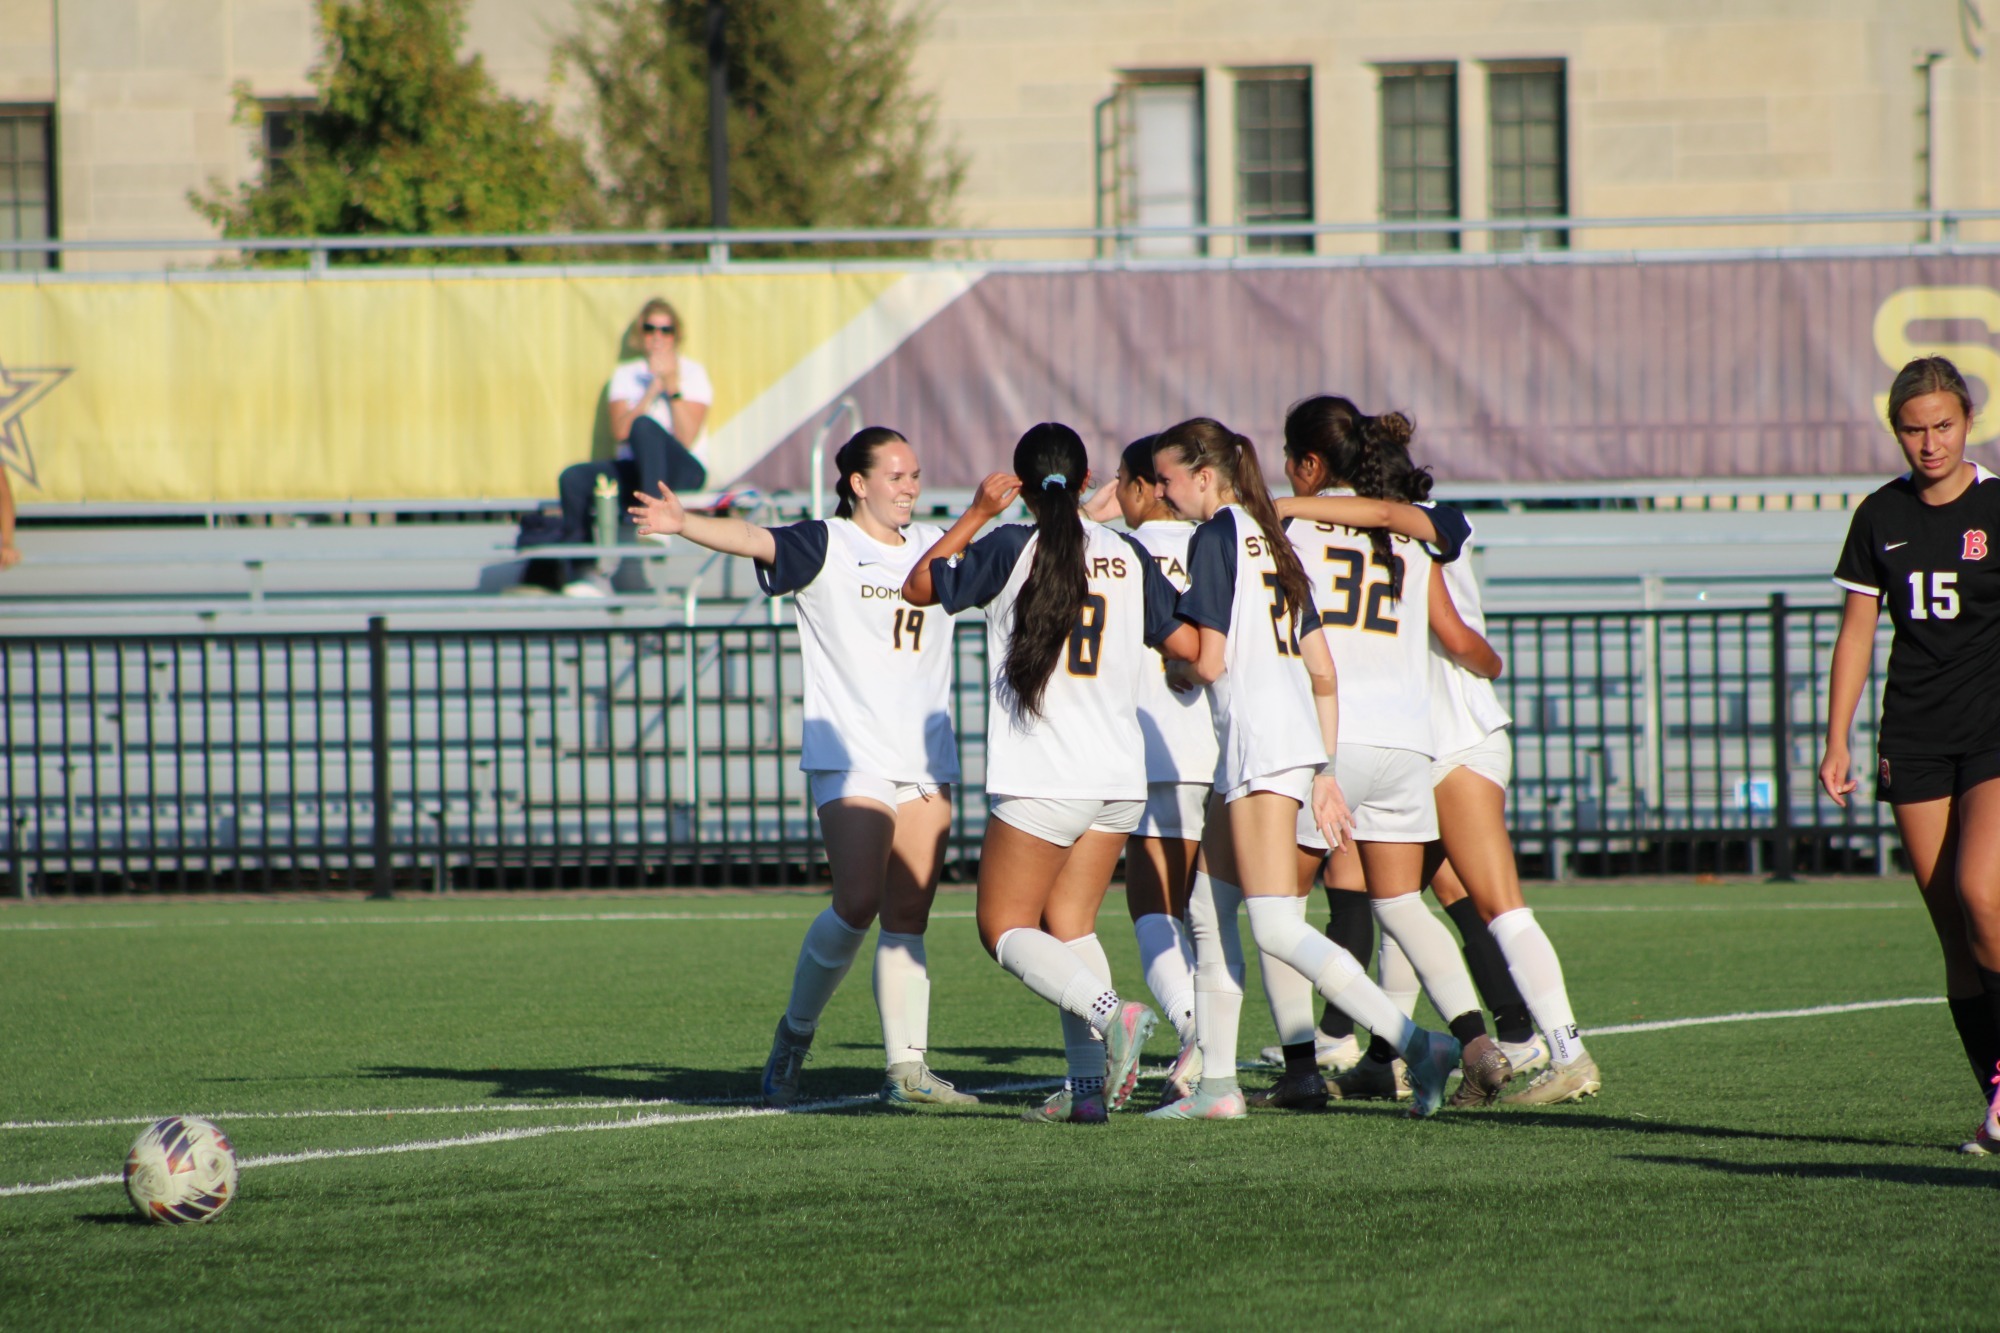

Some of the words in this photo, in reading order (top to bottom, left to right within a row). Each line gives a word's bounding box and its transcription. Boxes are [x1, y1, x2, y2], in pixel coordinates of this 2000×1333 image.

[1961, 529, 1988, 561] B
[1320, 543, 1407, 638] 32
[1908, 571, 1961, 620] 15
[893, 607, 926, 652] 19
[1064, 591, 1108, 679] 8
